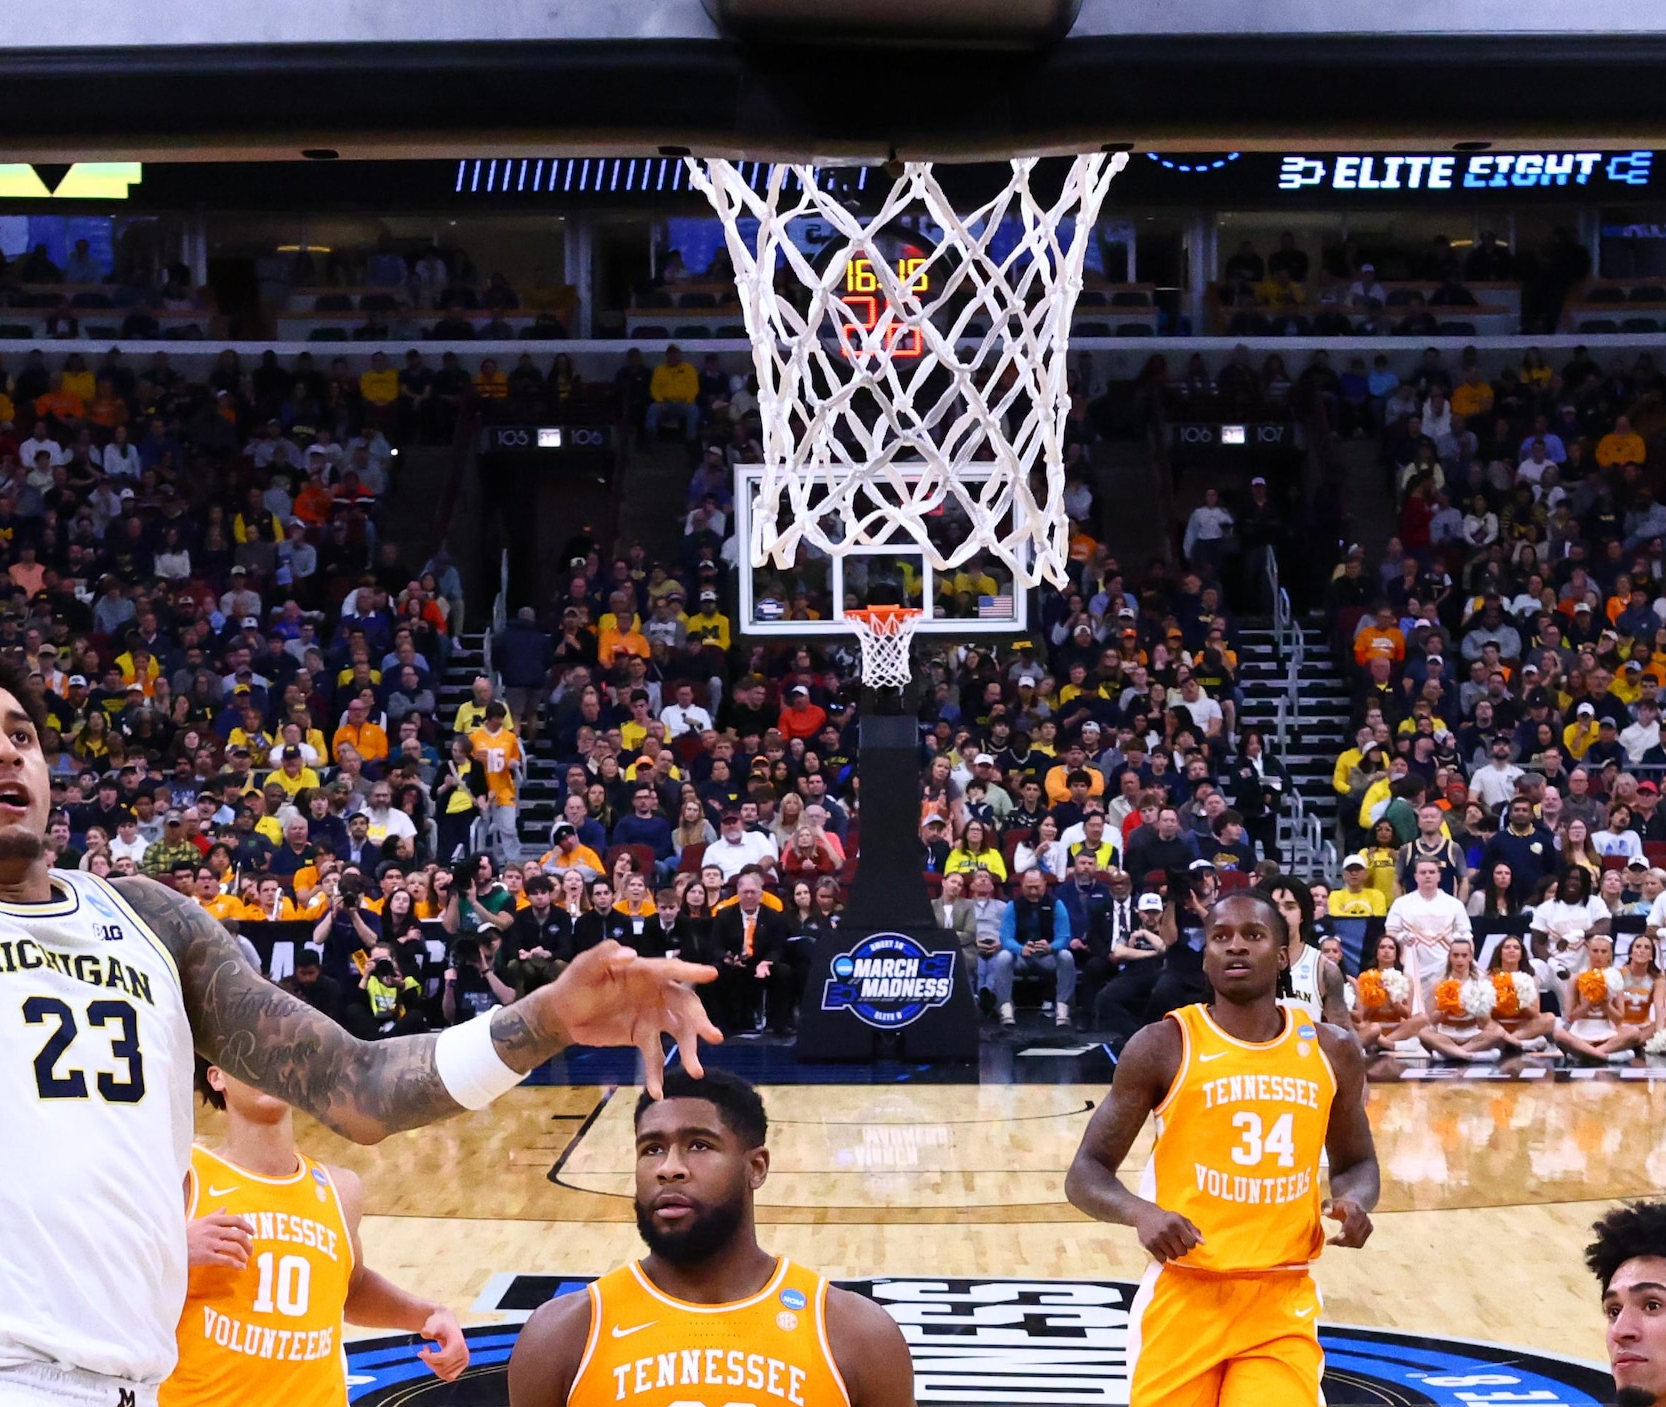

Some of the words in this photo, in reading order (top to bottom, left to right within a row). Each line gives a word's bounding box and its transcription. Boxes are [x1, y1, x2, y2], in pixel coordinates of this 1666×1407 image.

[1332, 155, 1456, 188] ELITE
[1462, 152, 1602, 188] EIGHT
[852, 958, 920, 978] MARCH
[860, 978, 950, 998] MADNESS
[21, 995, 146, 1105] 23
[1201, 1074, 1320, 1111] TENNESSEE
[1230, 1110, 1295, 1168] 34
[1194, 1162, 1312, 1205] VOLUNTEERS
[231, 1212, 339, 1262] NNESSEE
[252, 1251, 311, 1317] 10
[783, 1295, 805, 1307] NCAA
[202, 1304, 334, 1361] VOLUNTEERS
[613, 1348, 807, 1407] TENNESSEE
